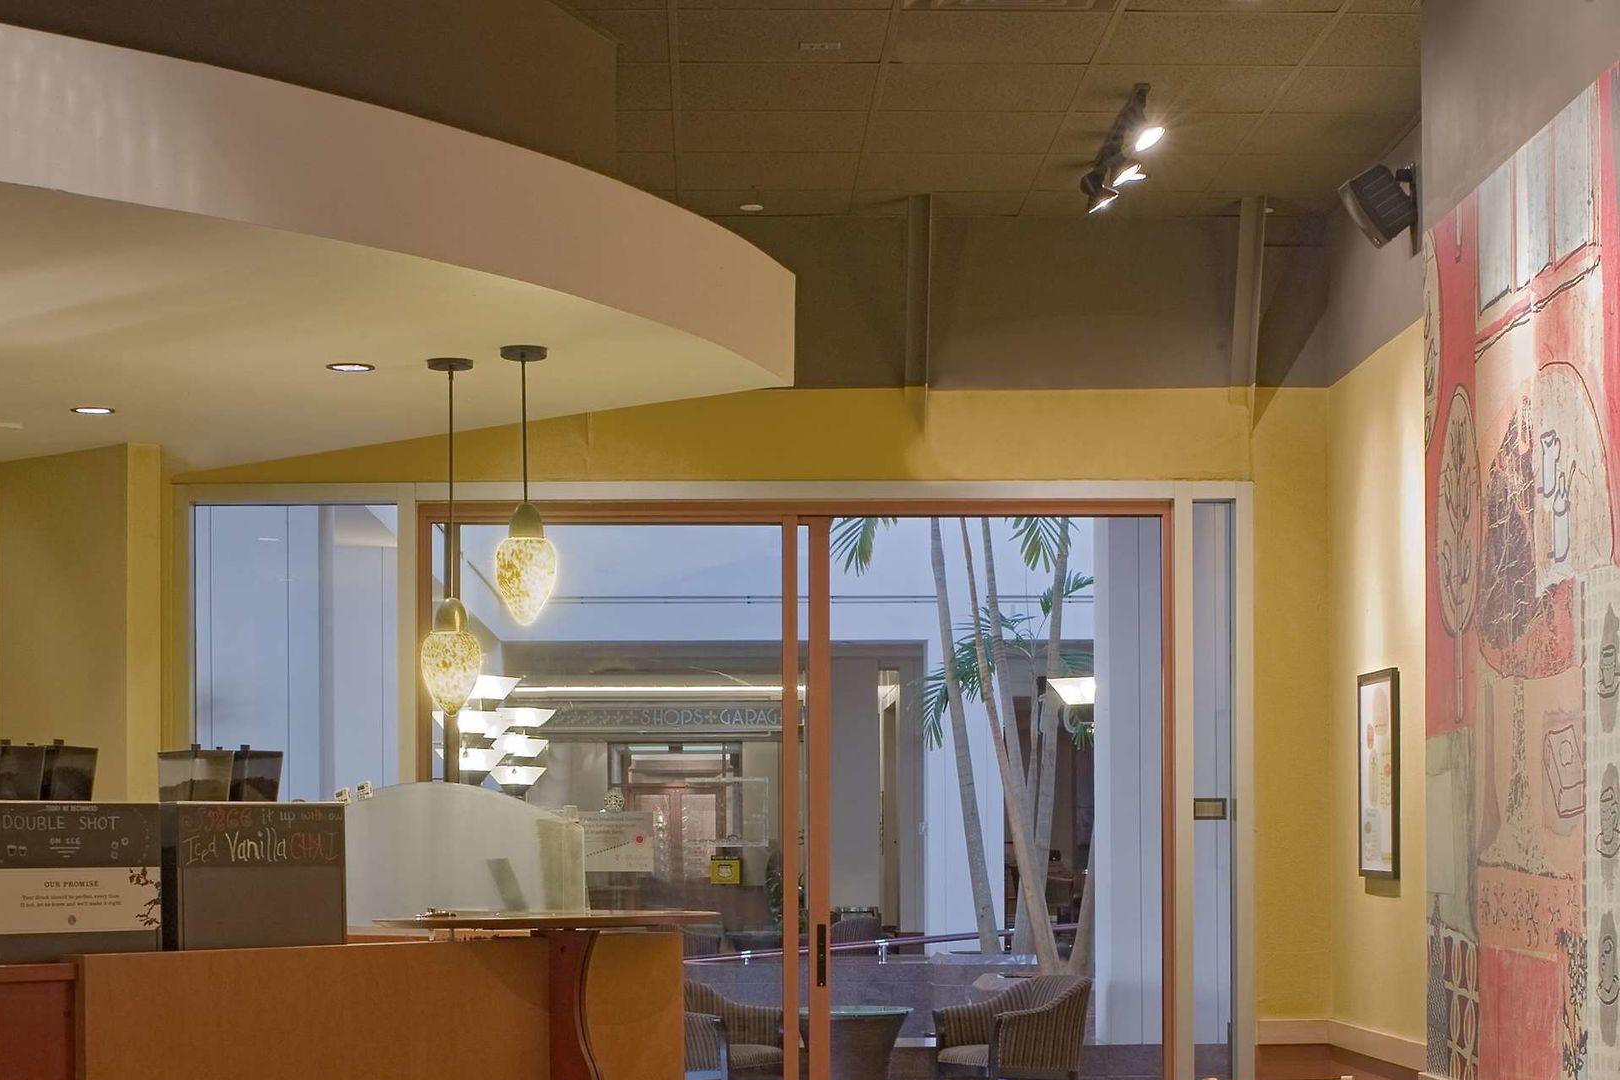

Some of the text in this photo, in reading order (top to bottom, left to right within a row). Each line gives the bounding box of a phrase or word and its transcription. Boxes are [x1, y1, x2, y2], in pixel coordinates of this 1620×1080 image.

[641, 708, 781, 726] SHOPS GARAG
[2, 815, 120, 831] DOUBLE SHOT
[280, 812, 295, 828] up
[182, 835, 218, 865] Iced
[226, 828, 288, 862] Vanilla
[63, 880, 100, 888] PROMISE
